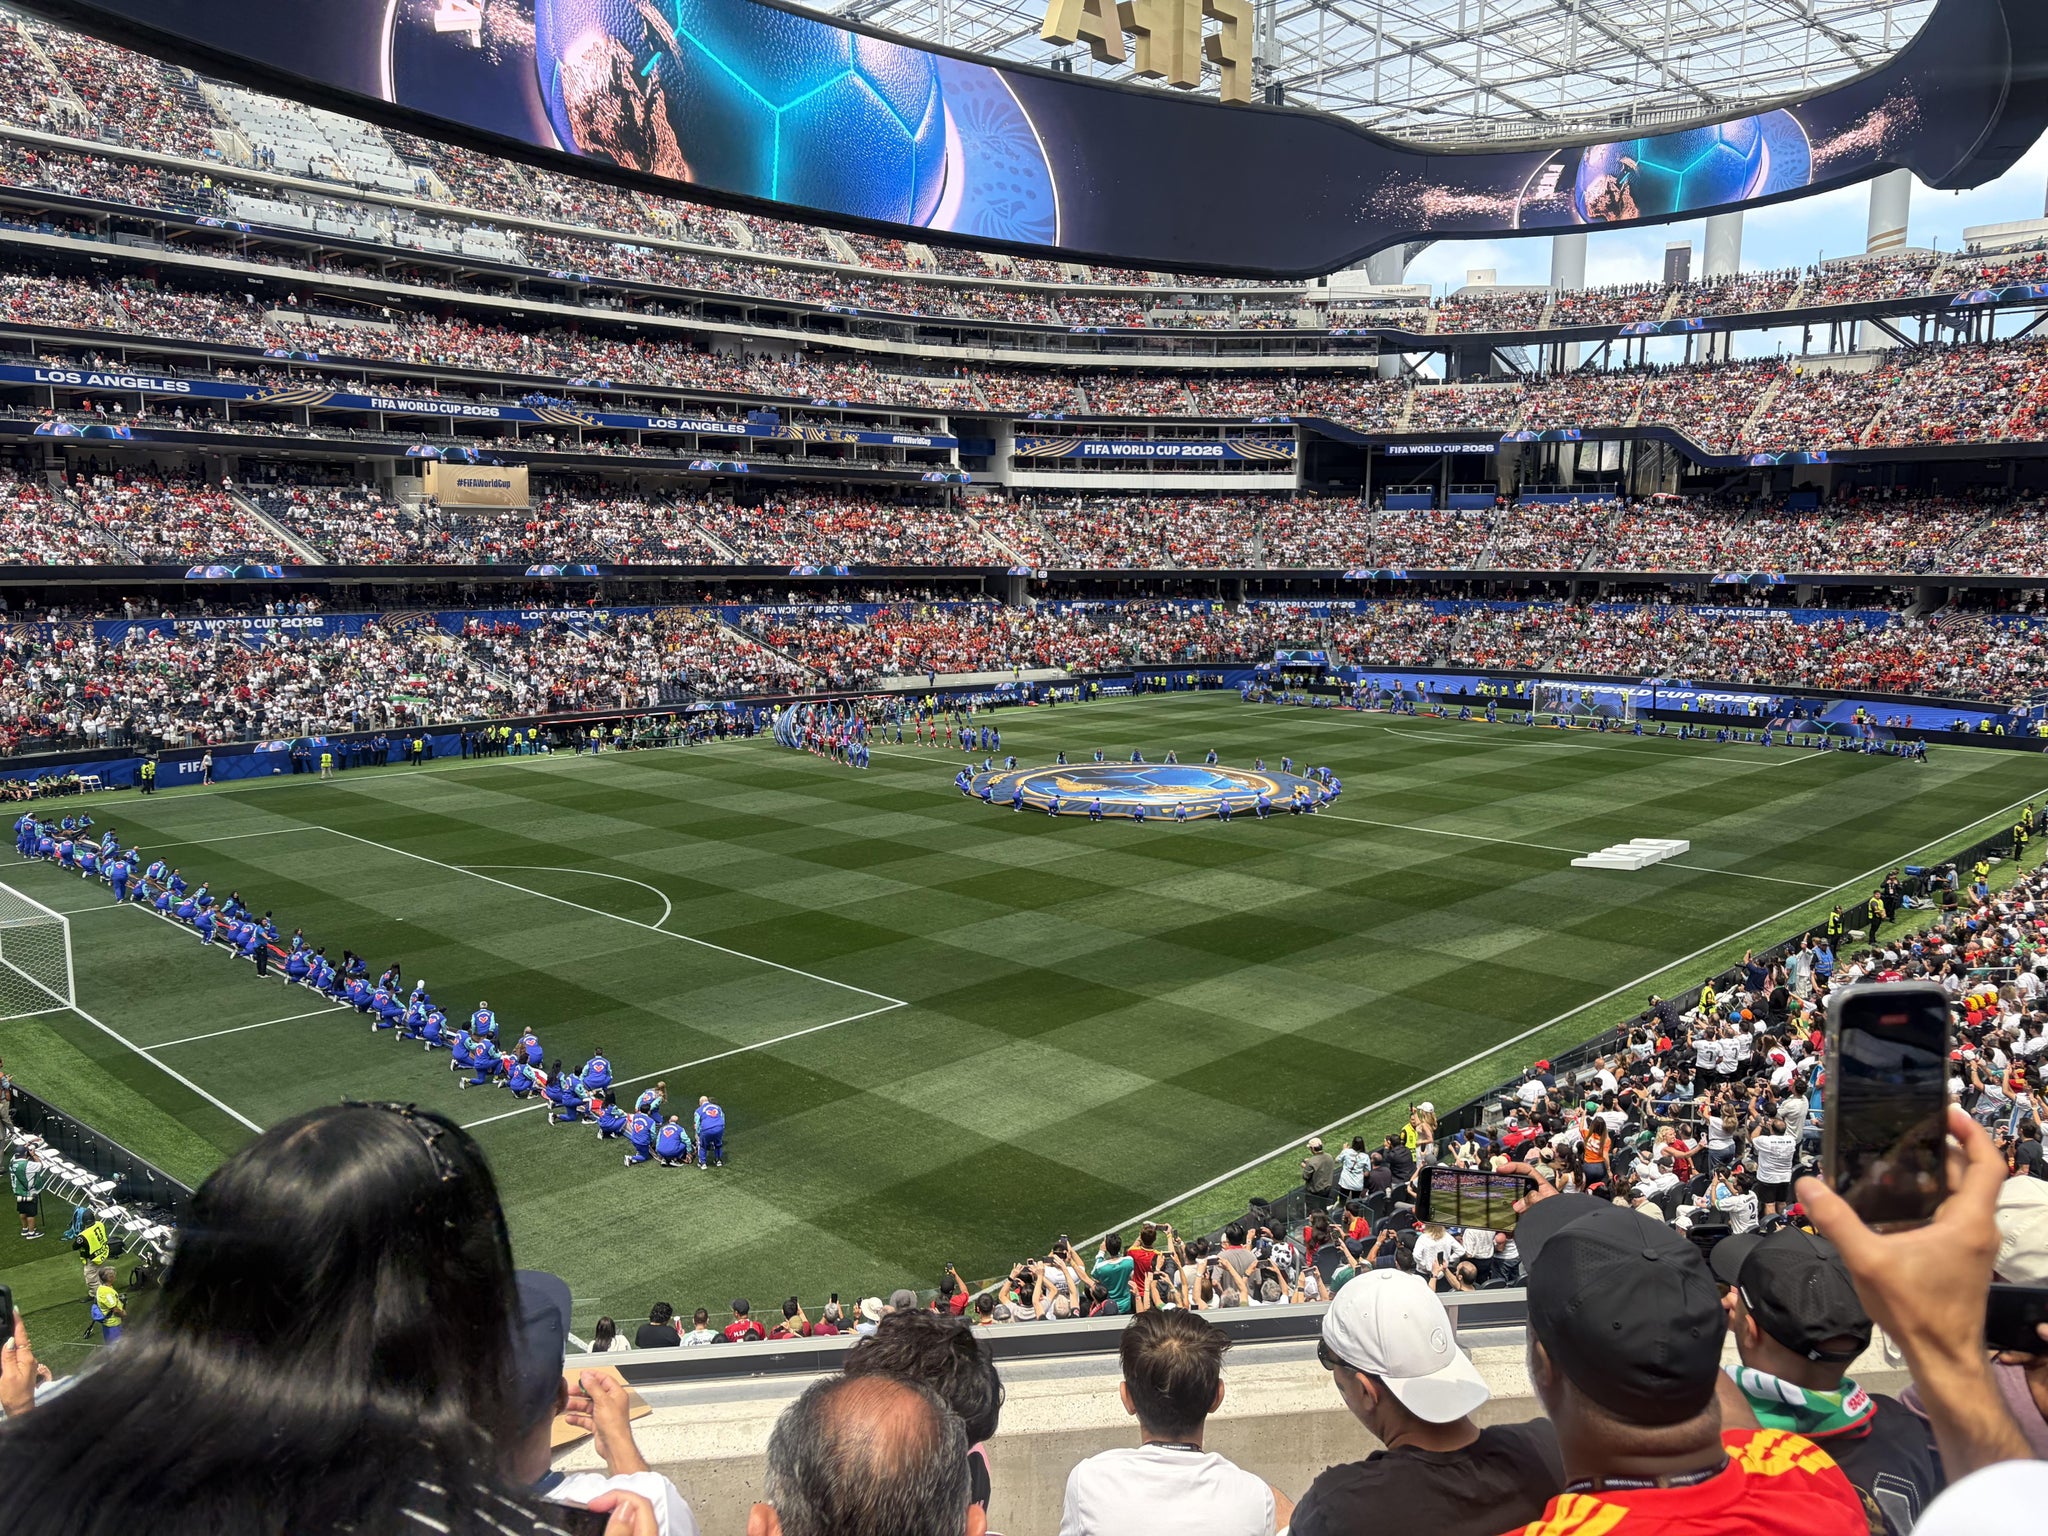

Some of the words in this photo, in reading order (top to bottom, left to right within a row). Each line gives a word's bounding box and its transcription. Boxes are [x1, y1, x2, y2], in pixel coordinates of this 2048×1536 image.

[34, 370, 82, 385] LOS
[86, 374, 191, 392] ANGELES
[371, 398, 397, 410] FIFA
[398, 400, 439, 413] WORLD
[440, 403, 461, 414] CUP
[462, 406, 500, 417] 2026
[648, 419, 677, 430] LOS
[680, 421, 746, 434] ANGELES
[892, 436, 932, 446] #FIFAWorldCup
[1084, 444, 1110, 455] FIFA
[1111, 445, 1153, 455] WORLD
[1155, 445, 1180, 456] CUP
[1181, 446, 1223, 456] 2026
[1389, 446, 1408, 454] FIFA
[1409, 445, 1442, 454] WORLD
[1443, 445, 1461, 453] CUP
[1462, 444, 1494, 453] 2026
[456, 478, 511, 489] #FIFAWorldCup
[778, 606, 807, 614] WORD
[825, 605, 852, 613] 206
[1277, 601, 1309, 609] WORLD
[521, 612, 547, 620] LOS
[551, 610, 609, 619] ANGEES
[253, 619, 280, 628] CUP
[281, 617, 324, 627] 2026
[1582, 684, 1653, 696] WORLD
[1655, 690, 1695, 699] CUP
[1696, 693, 1771, 703] 2026
